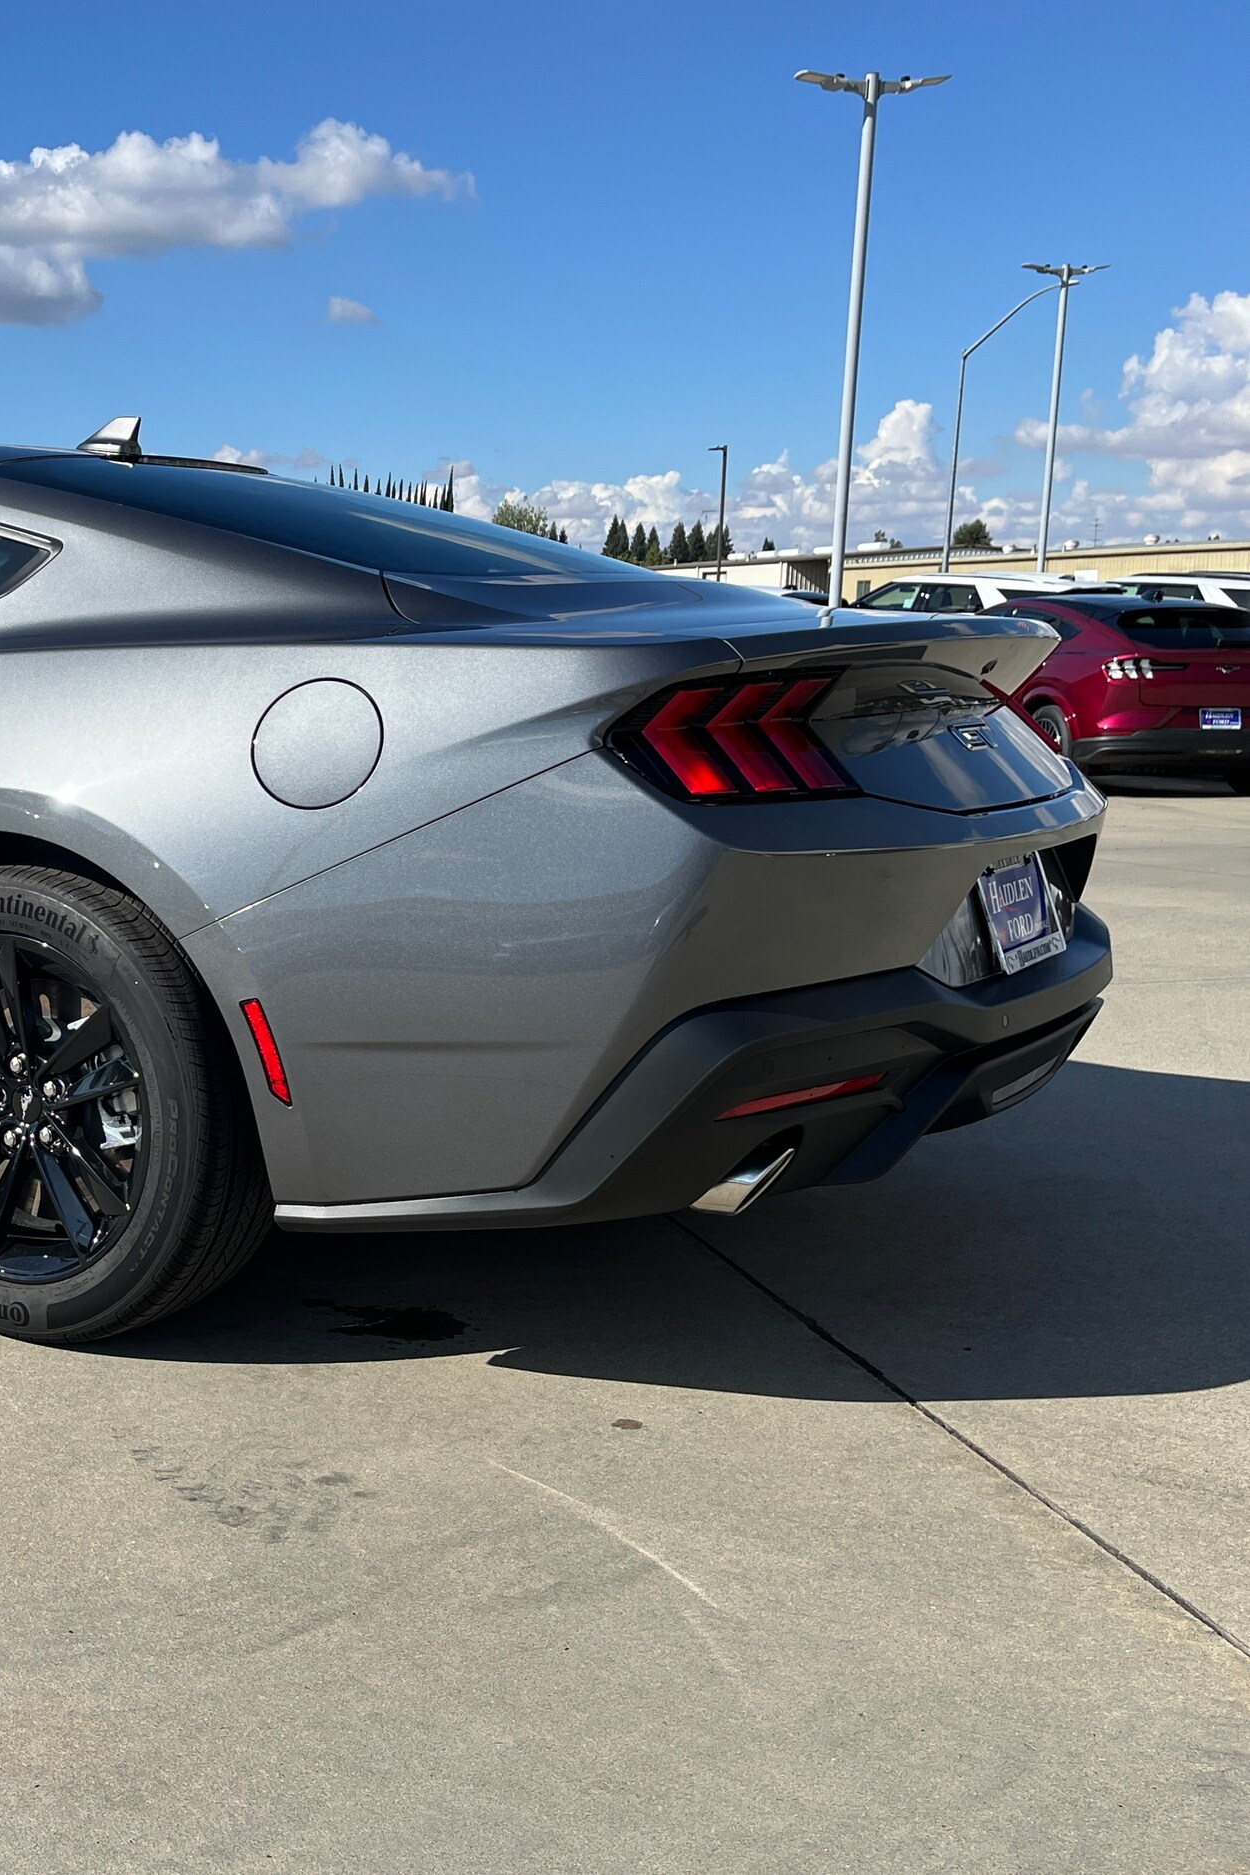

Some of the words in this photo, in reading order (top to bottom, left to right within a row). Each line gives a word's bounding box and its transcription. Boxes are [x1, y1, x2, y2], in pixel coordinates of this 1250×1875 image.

[947, 722, 999, 751] GT
[988, 876, 1034, 914] HAIDLEN
[1007, 913, 1034, 941] FORD
